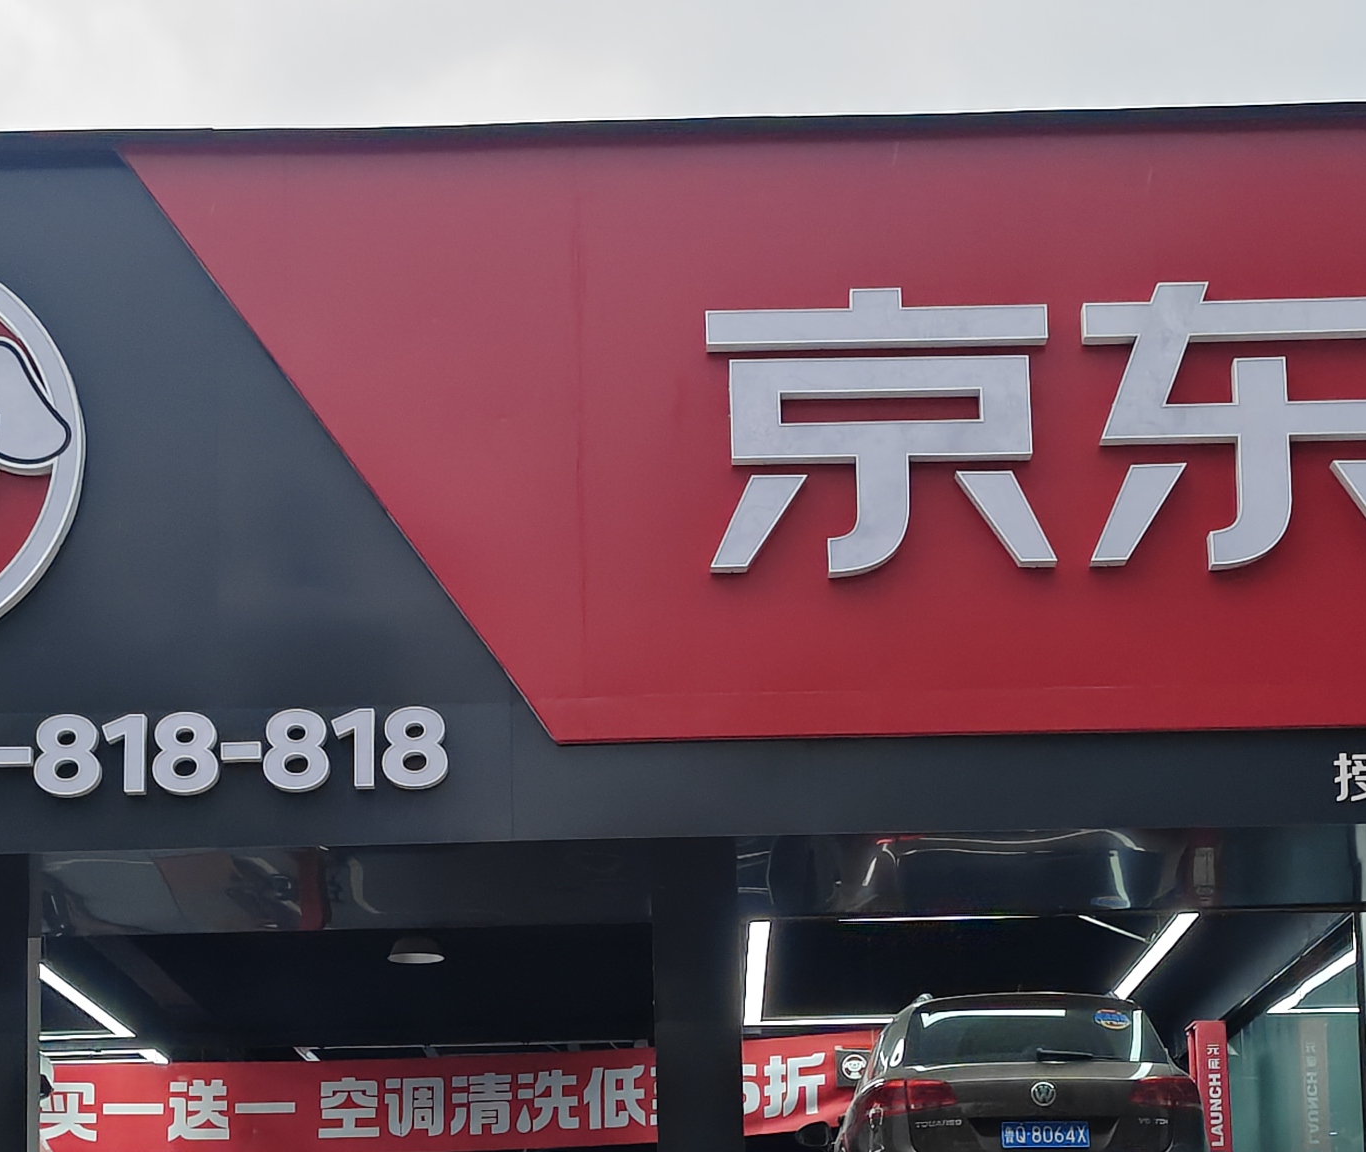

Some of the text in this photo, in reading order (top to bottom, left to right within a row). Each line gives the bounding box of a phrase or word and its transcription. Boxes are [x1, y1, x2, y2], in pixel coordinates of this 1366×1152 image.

[40, 1052, 826, 1142] 买一送一 空调清洗低5折
[1208, 1072, 1225, 1147] LAUNCH
